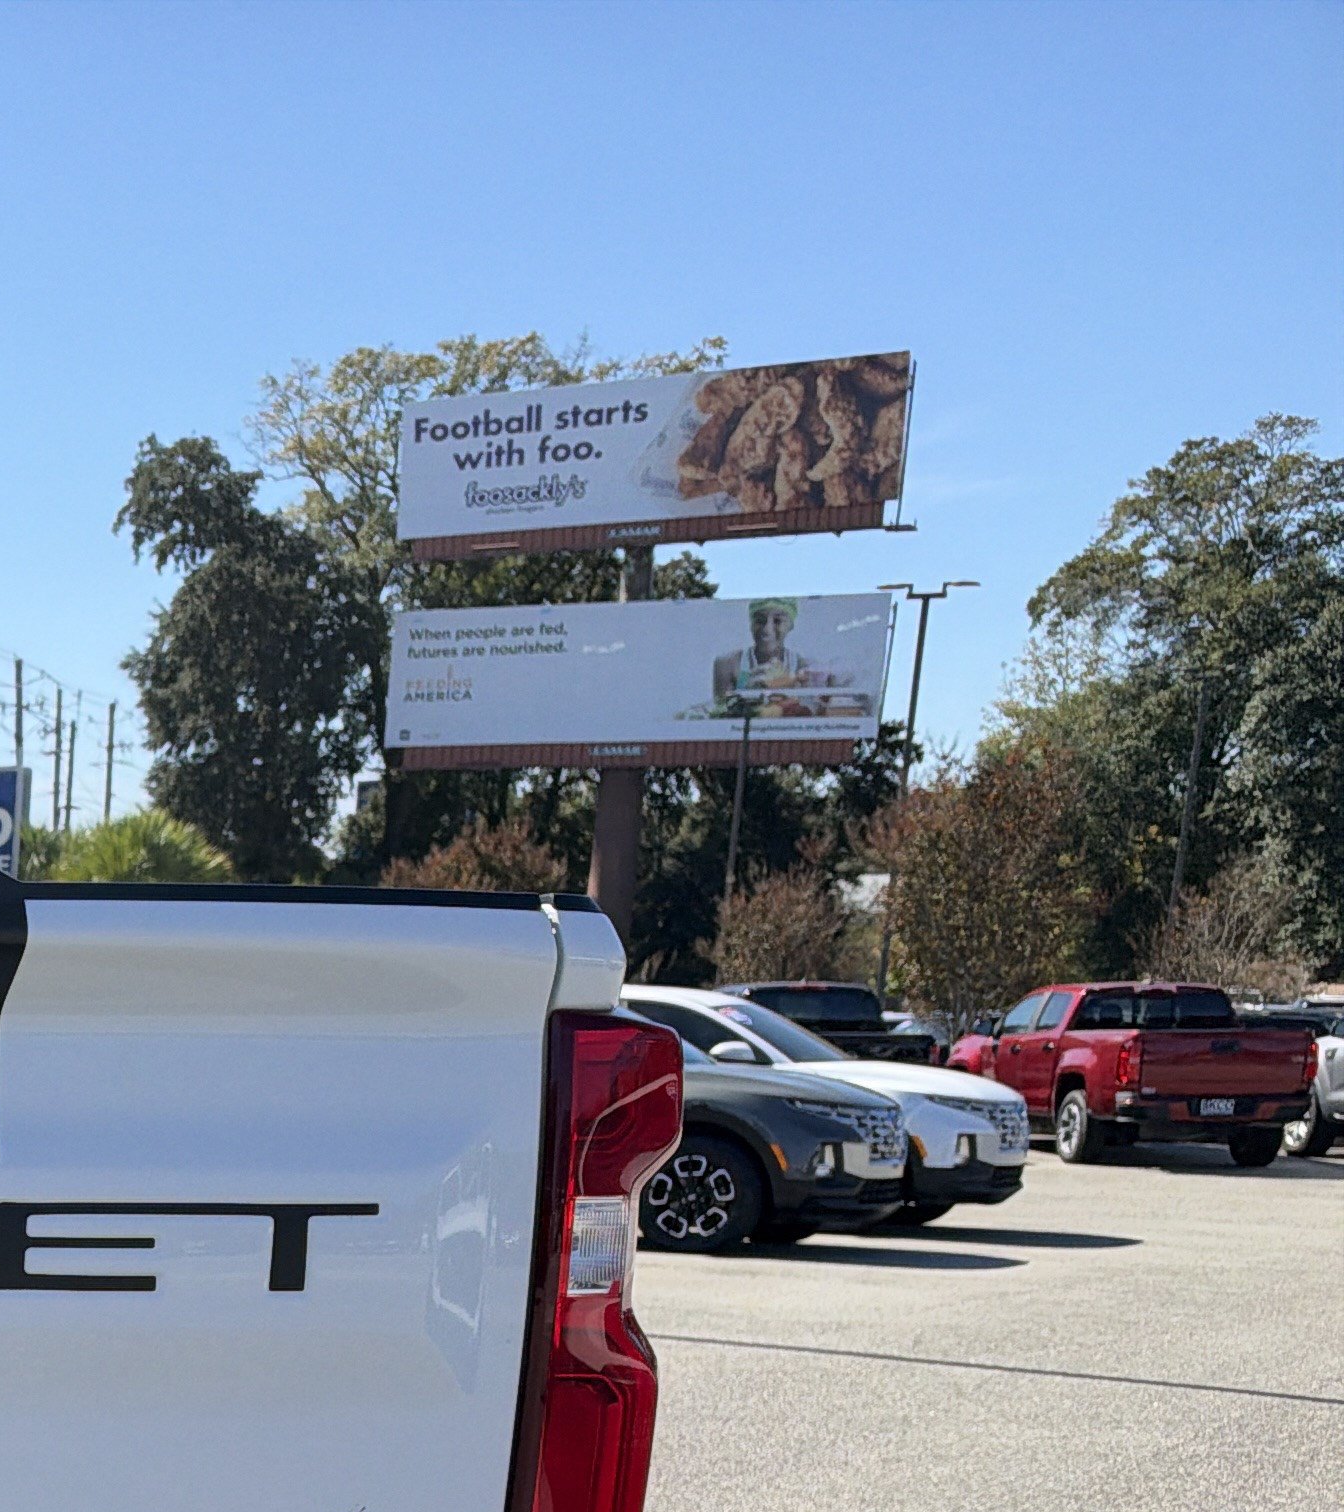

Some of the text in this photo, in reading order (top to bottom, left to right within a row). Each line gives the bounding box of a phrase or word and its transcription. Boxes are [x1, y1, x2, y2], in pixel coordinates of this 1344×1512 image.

[414, 400, 649, 443] Football starts
[453, 435, 603, 470] with foo.
[409, 628, 451, 640] When
[455, 625, 506, 641] people
[511, 625, 534, 637] are
[407, 645, 458, 659] futures
[463, 645, 485, 656] are
[403, 690, 472, 702] AMERICA
